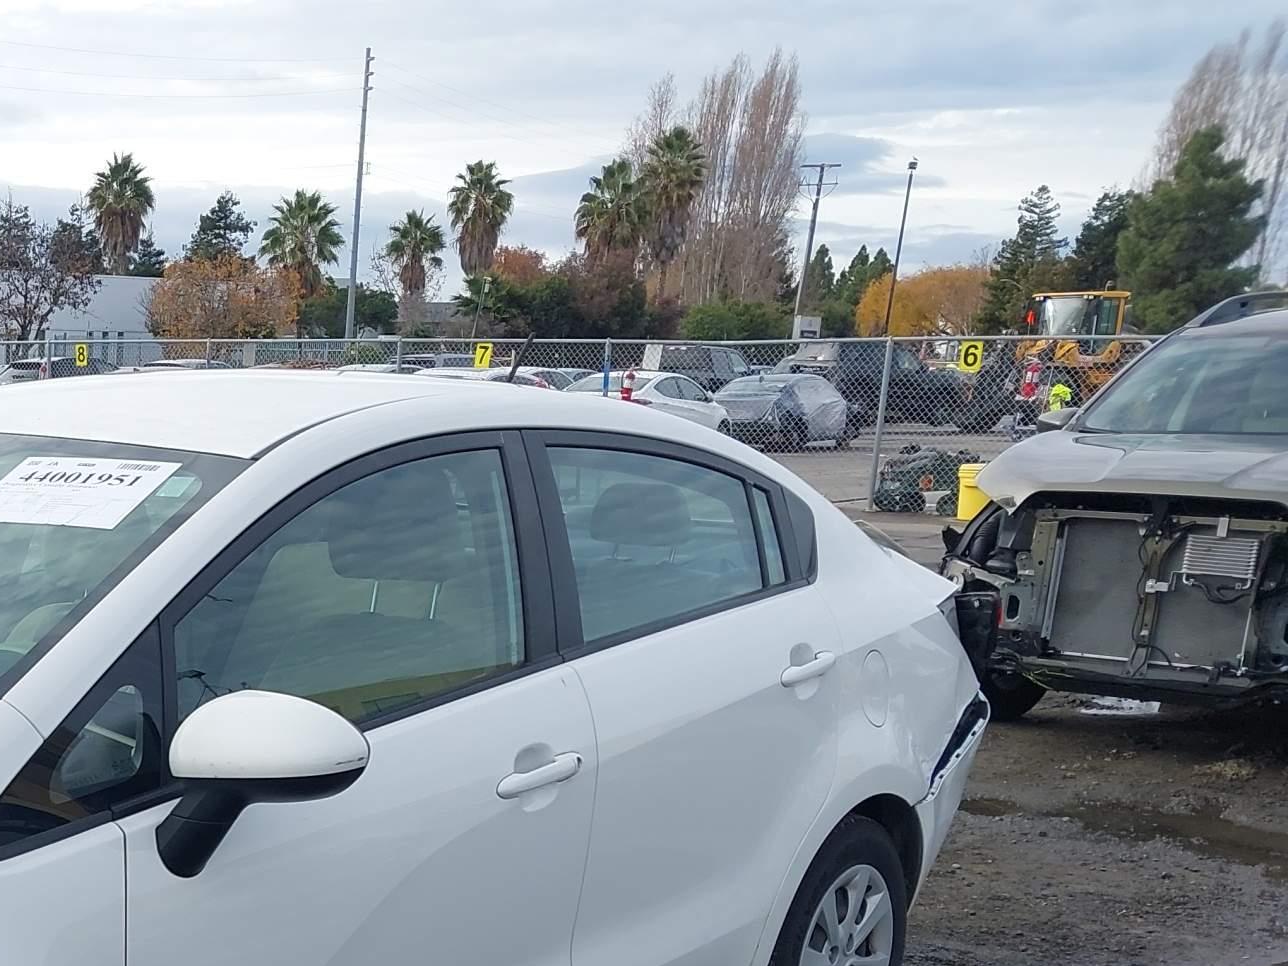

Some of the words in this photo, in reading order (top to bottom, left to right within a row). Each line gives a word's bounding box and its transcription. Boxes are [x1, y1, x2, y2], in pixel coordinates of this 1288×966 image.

[78, 346, 86, 362] 8
[478, 345, 489, 364] 7
[963, 344, 979, 367] 6
[19, 471, 142, 486] 44001951
